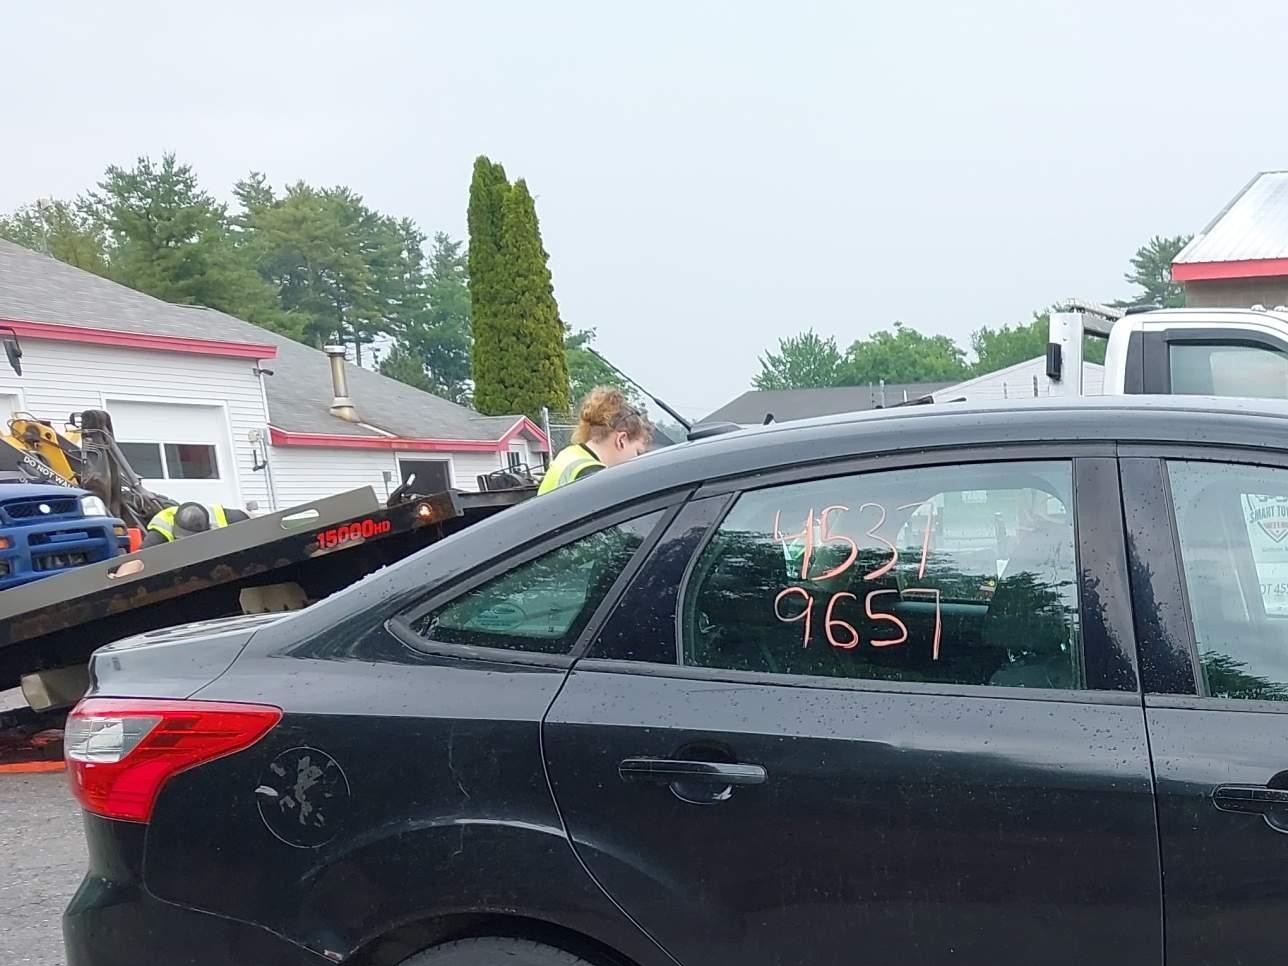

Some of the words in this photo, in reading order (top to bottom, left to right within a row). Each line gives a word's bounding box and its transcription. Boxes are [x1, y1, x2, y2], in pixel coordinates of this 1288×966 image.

[23, 456, 37, 467] DO
[37, 465, 55, 478] NOT
[1249, 505, 1275, 524] SMART
[774, 501, 934, 581] 4537
[774, 586, 942, 661] 9657
